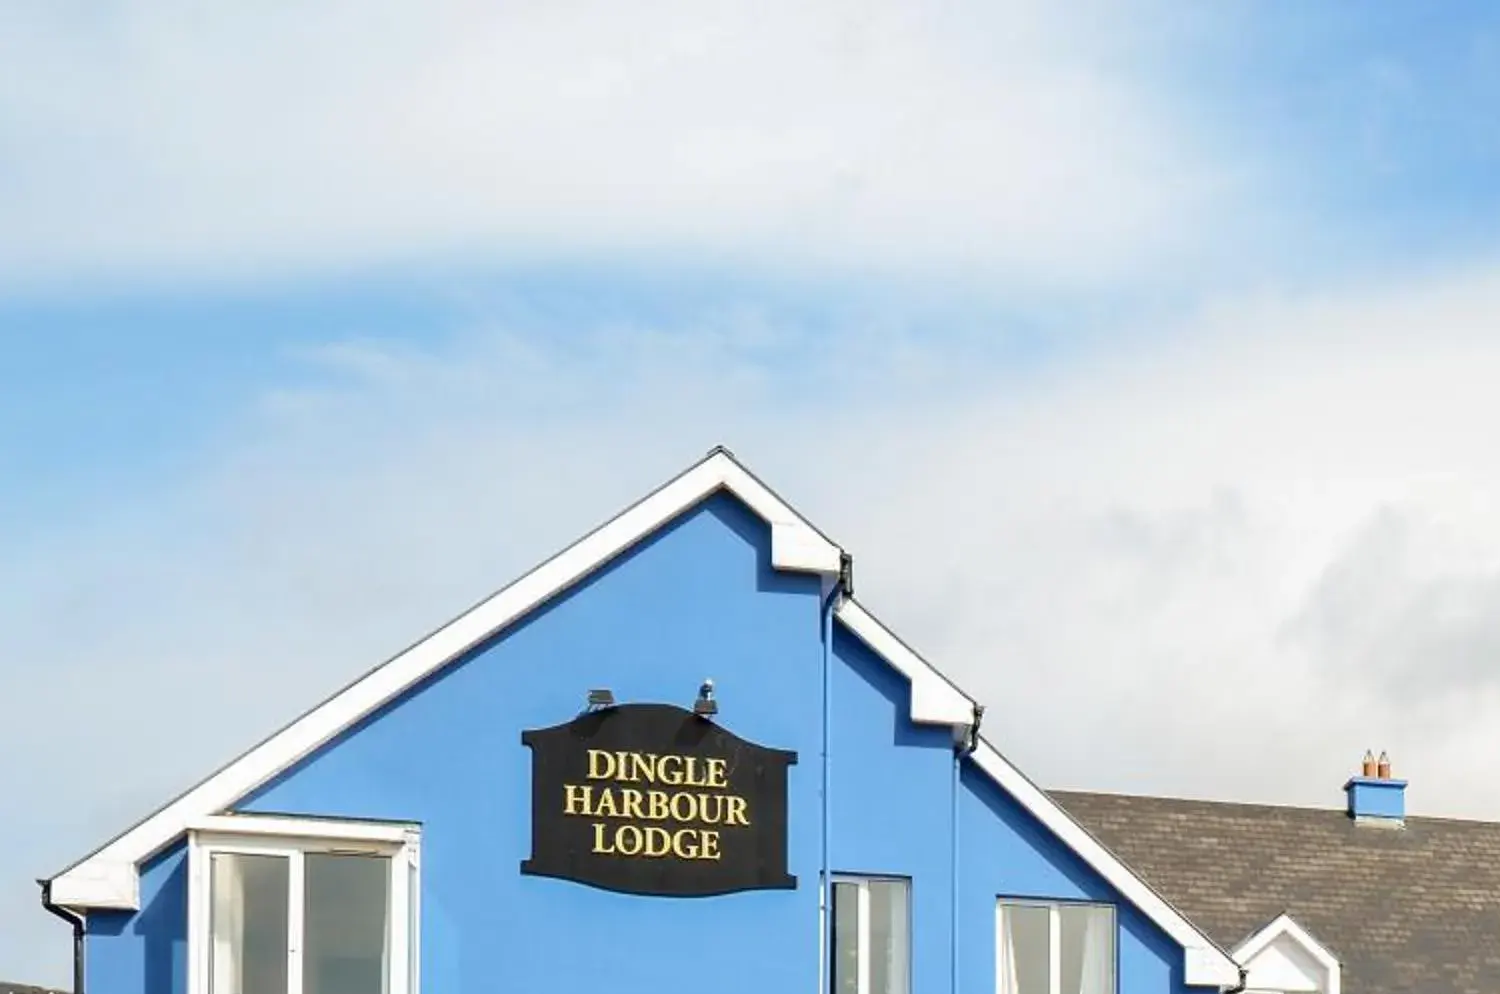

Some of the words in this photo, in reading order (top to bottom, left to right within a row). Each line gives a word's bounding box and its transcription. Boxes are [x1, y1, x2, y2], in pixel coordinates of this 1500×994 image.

[586, 749, 728, 787] DINGLE
[563, 784, 750, 825] HARBOUR
[591, 823, 721, 860] LODGE
